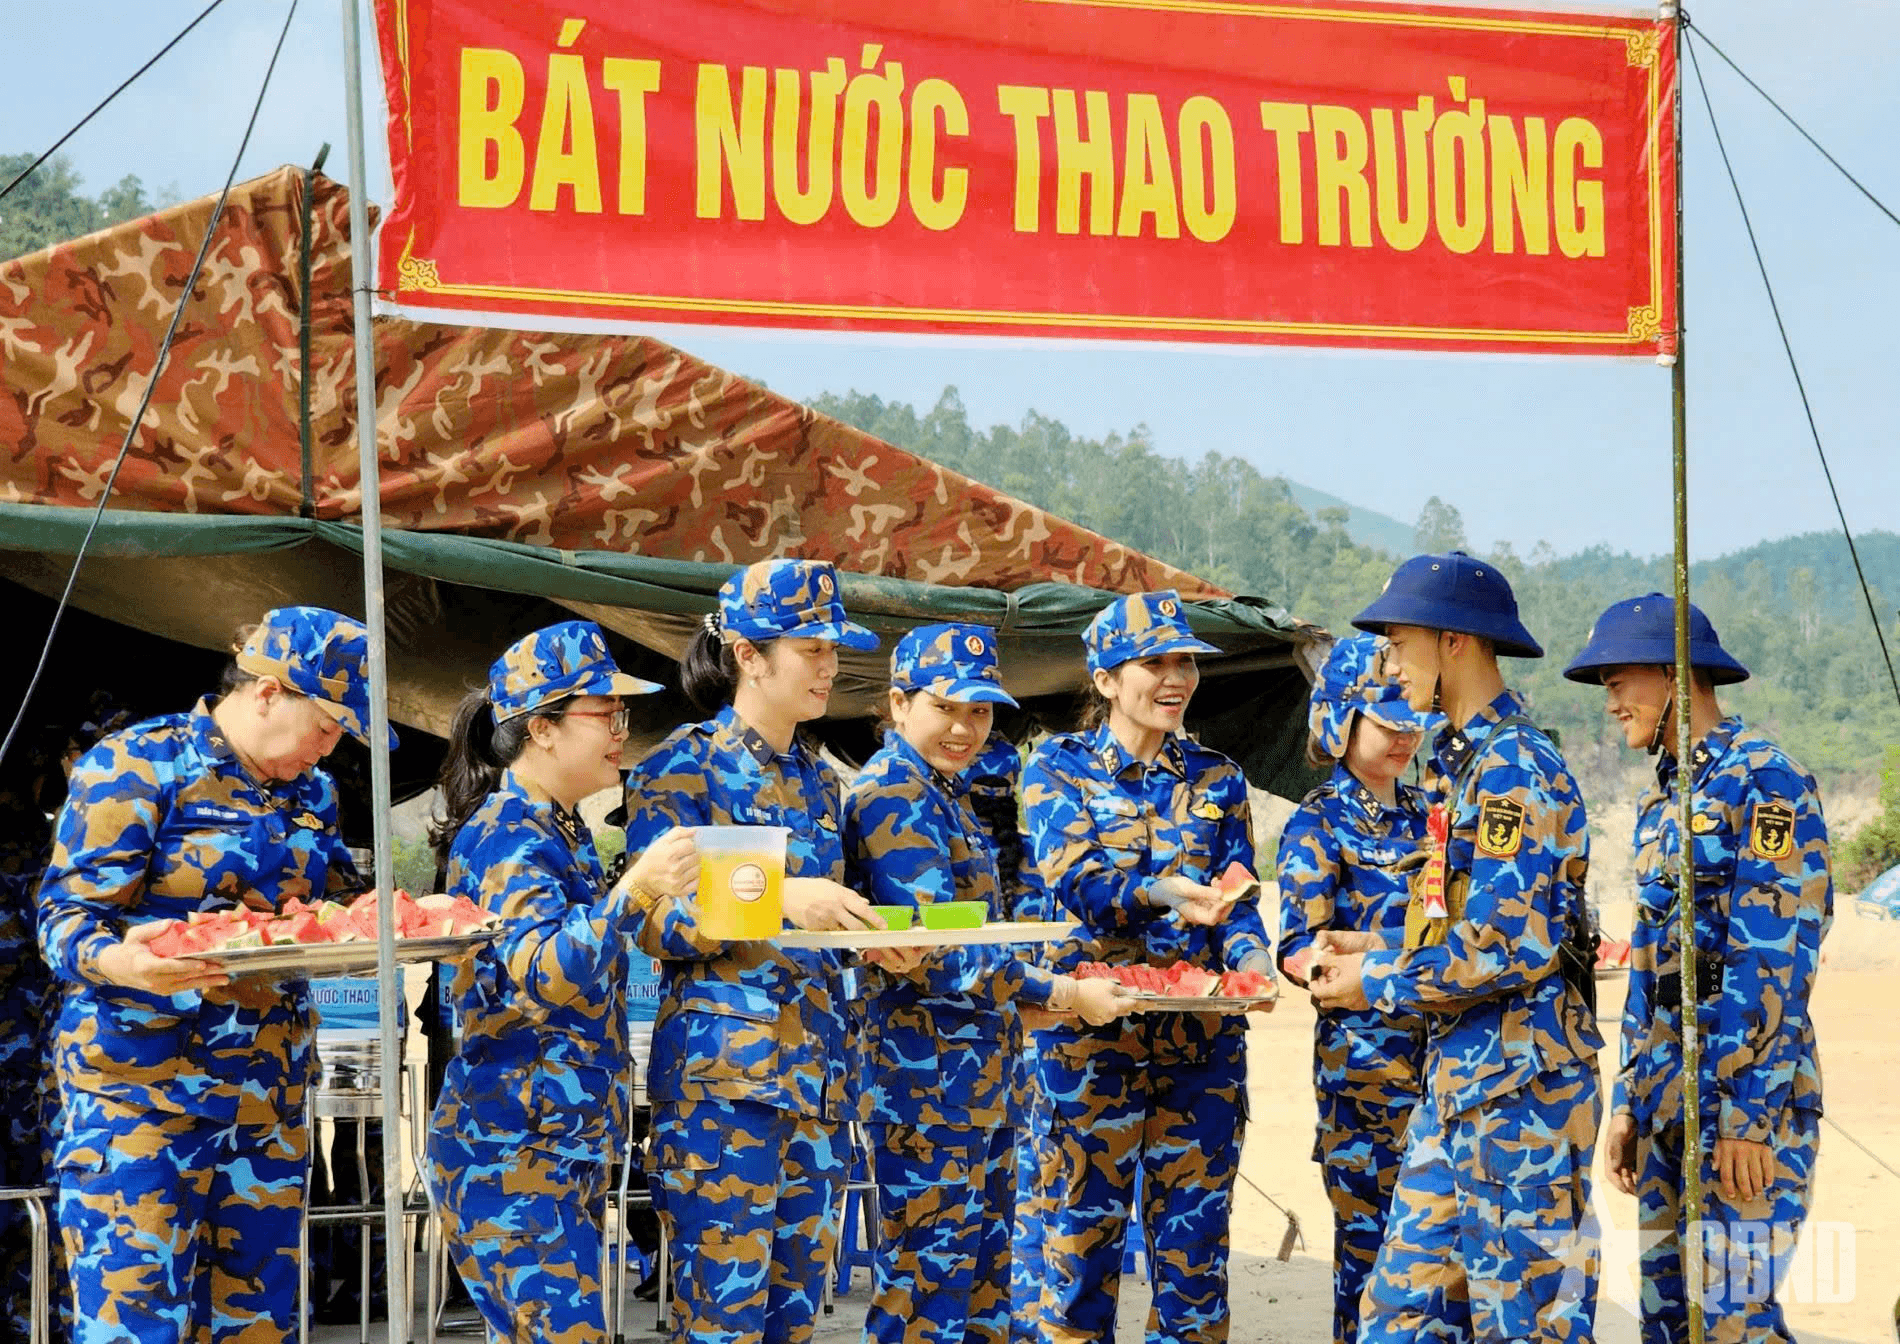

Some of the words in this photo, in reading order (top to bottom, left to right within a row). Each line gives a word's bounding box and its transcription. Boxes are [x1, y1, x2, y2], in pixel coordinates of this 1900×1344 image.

[459, 18, 661, 216] BÁT
[696, 43, 969, 231] NƯỚC
[997, 85, 1238, 243] THAO
[1260, 76, 1605, 258] TRƯỜNG
[343, 988, 371, 1004] THAO
